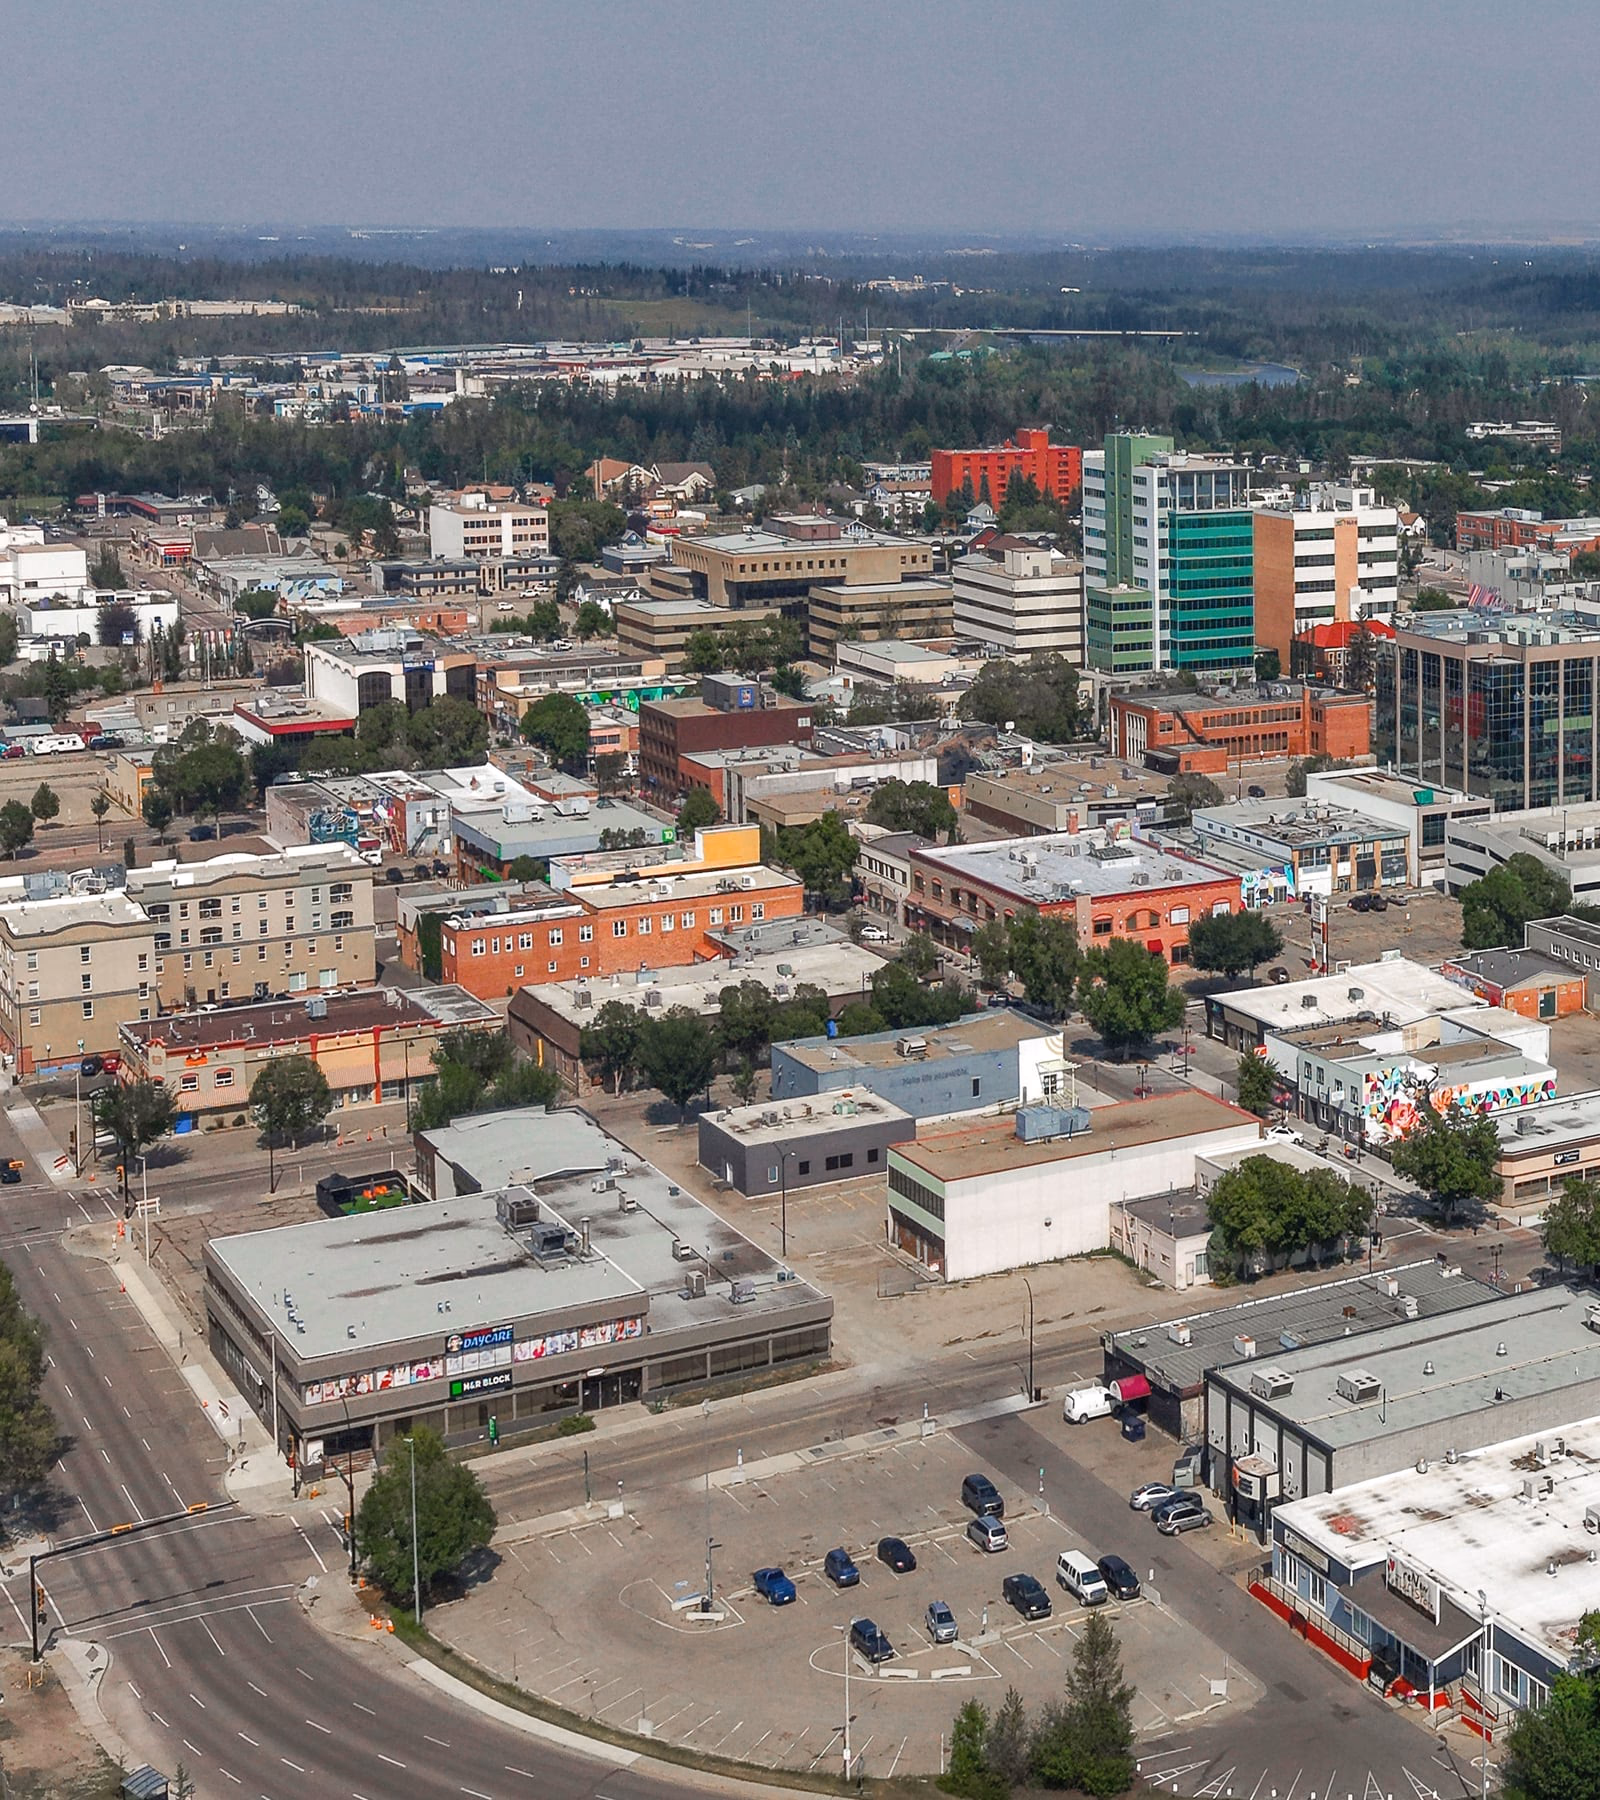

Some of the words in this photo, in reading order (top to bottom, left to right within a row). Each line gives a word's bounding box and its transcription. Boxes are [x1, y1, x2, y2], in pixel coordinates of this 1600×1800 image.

[464, 1330, 513, 1348] DAYCARE
[463, 1380, 481, 1391] H&R
[482, 1374, 510, 1386] BLOCK
